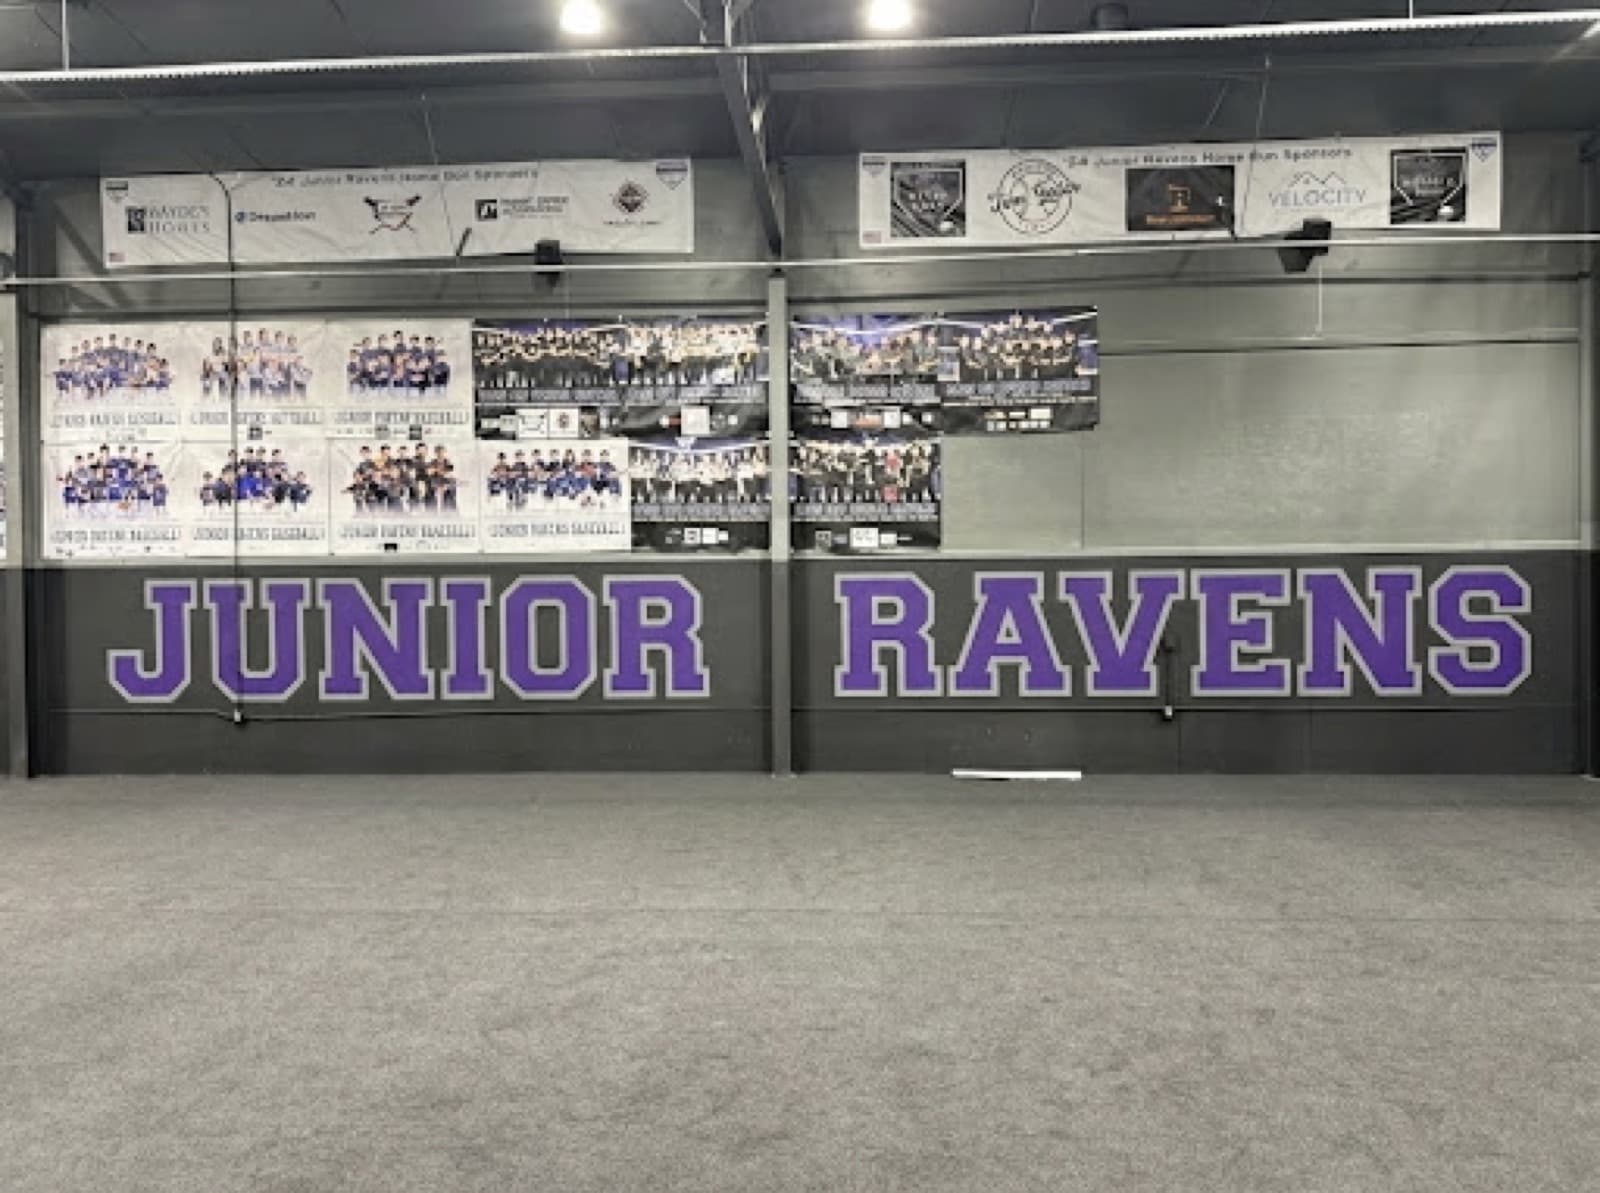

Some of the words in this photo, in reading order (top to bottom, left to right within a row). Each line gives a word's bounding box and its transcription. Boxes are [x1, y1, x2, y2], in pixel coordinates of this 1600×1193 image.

[1143, 153, 1198, 165] Ravens
[1202, 151, 1245, 163] Home
[1283, 148, 1352, 162] Sponsors
[1267, 188, 1367, 208] VELOCITY
[107, 575, 710, 703] JUNIOR
[834, 565, 1532, 698] RAVENS
